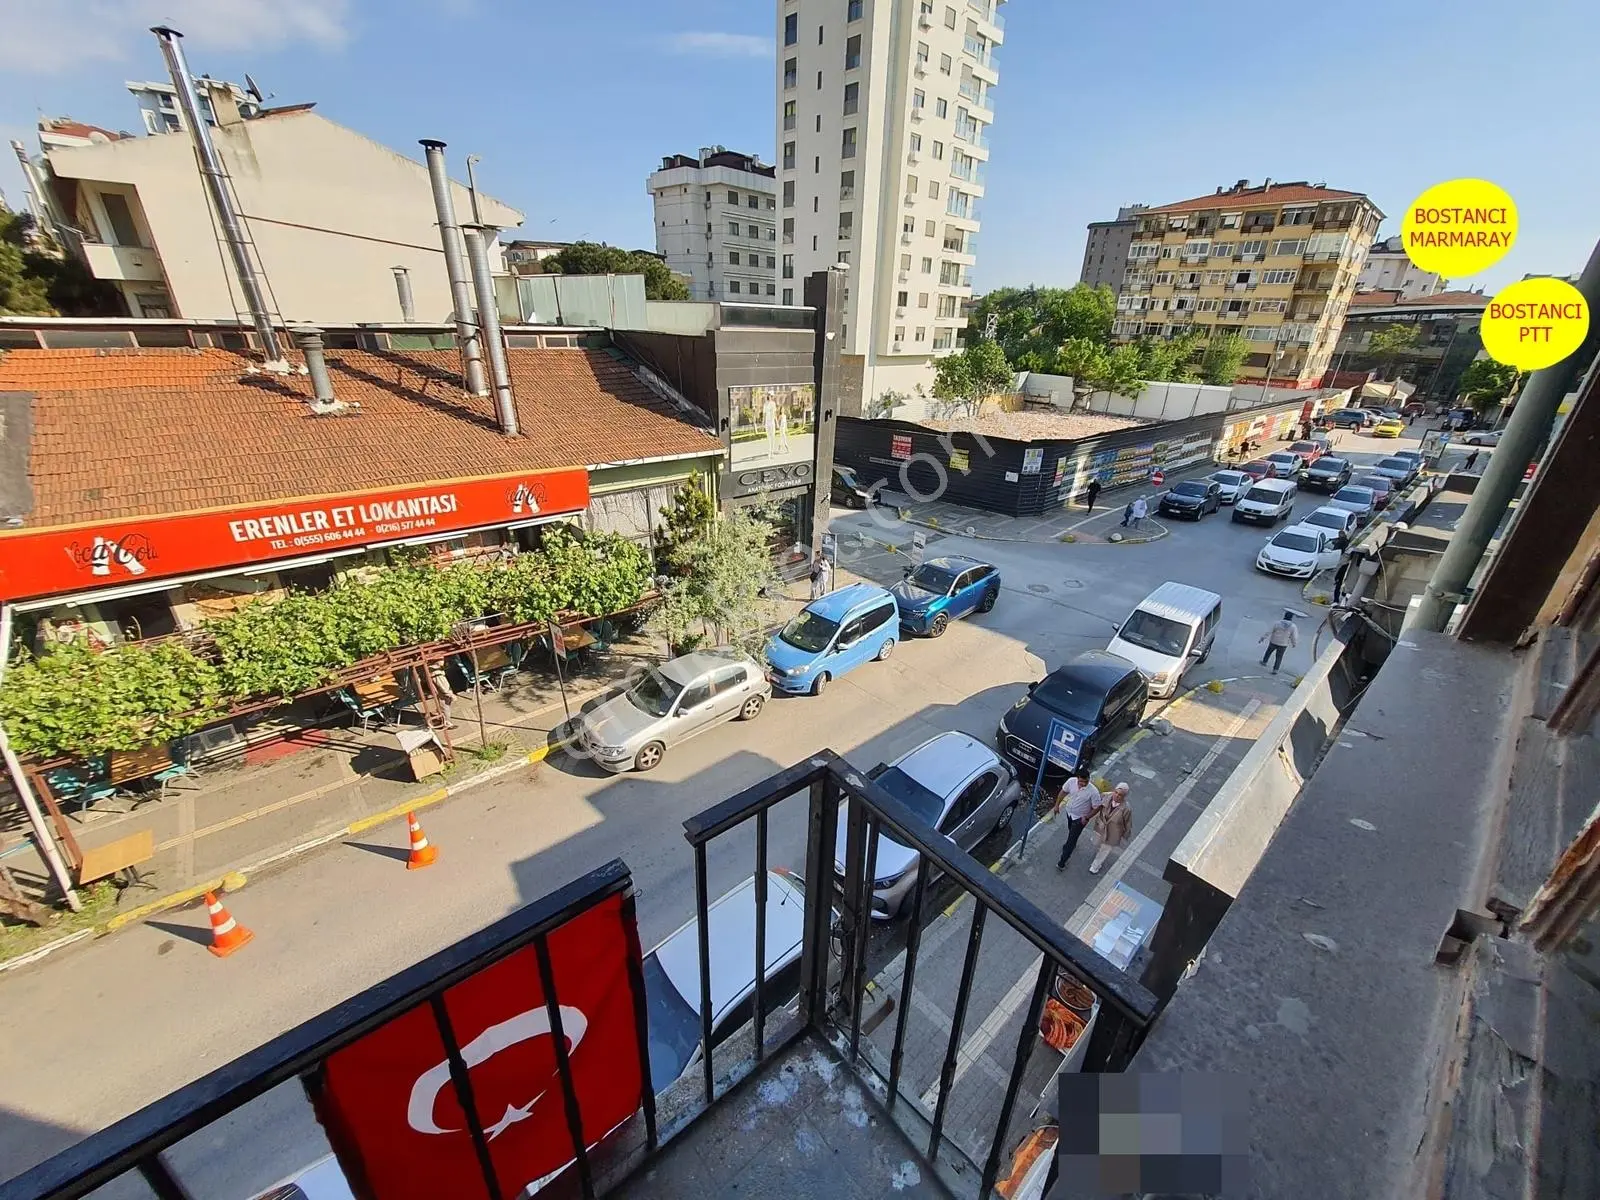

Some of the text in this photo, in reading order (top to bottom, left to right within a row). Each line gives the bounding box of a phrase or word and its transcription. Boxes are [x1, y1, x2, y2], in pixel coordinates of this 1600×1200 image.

[738, 463, 811, 486] CEYO
[229, 494, 458, 543] ERENLER ET LOKANTASI
[270, 539, 288, 549] TEL
[293, 535, 324, 547] 0(555)
[324, 531, 341, 542] 606
[342, 530, 353, 539] 44
[354, 528, 365, 537] 44
[375, 522, 401, 535] 0(216)
[401, 519, 414, 531] 577
[414, 519, 425, 529] 44
[425, 517, 436, 527] 44
[1060, 729, 1075, 744] P
